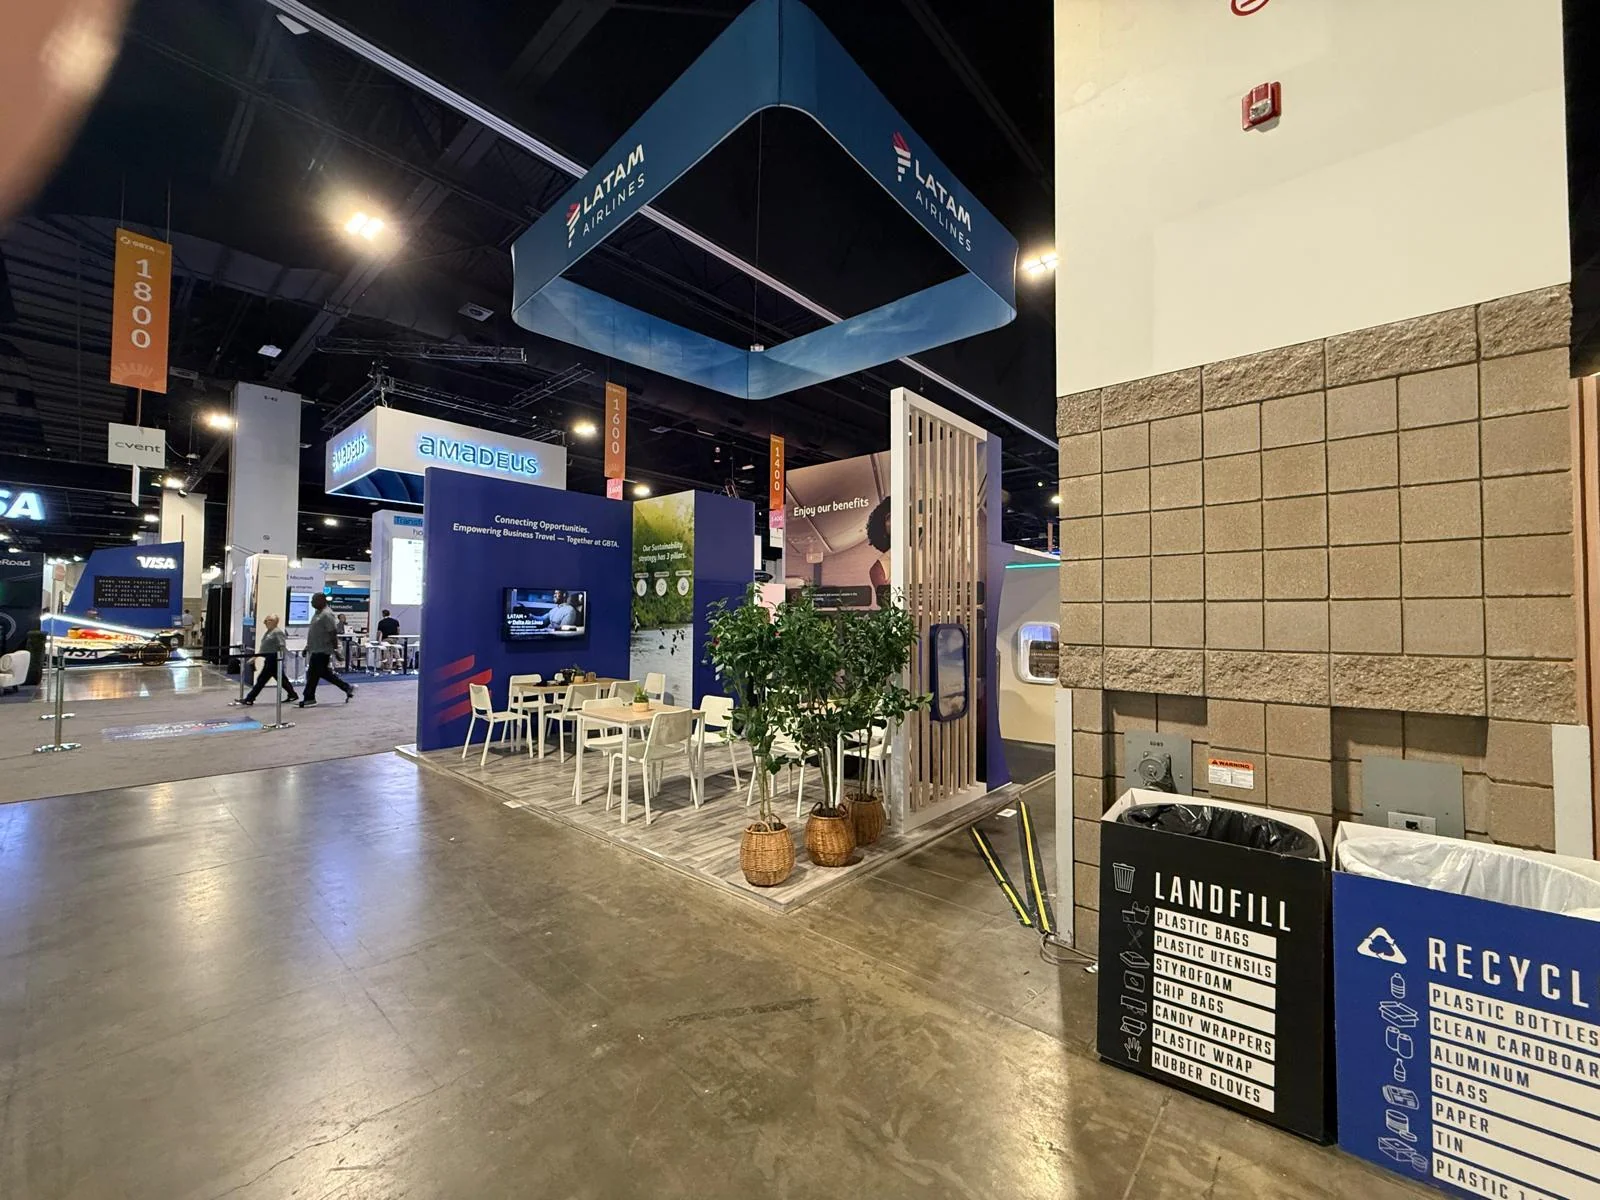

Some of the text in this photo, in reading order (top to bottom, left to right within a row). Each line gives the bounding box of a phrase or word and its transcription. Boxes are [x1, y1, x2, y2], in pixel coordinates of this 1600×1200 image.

[583, 144, 645, 214] LATAM
[915, 159, 972, 231] LATAM
[582, 173, 645, 237] AIRLINES
[916, 190, 972, 252] AIRLINES
[131, 259, 152, 348] 1800
[115, 441, 161, 453] cvent
[612, 398, 620, 455] 1600
[494, 514, 590, 534] Connecting Opportunities.
[793, 497, 869, 518] Enjoy our benefits
[453, 523, 501, 537] Empowering
[503, 528, 533, 539] Business
[535, 532, 556, 541] Travel
[566, 535, 593, 546] Together
[602, 539, 620, 548] GBTA.
[652, 541, 683, 551] Sustainability
[136, 556, 176, 569] VISA
[332, 563, 355, 571] HRS
[638, 555, 656, 563] strategy
[657, 553, 665, 561] has
[1219, 761, 1250, 769] WARNING
[1155, 872, 1291, 932] LANDFILL
[1157, 911, 1250, 947] PLASTIC BAGS
[1156, 935, 1272, 978] PLASTIC UTENSILS
[1156, 958, 1232, 992] STYROFOAM
[1428, 937, 1589, 1008] RECYCL
[1155, 981, 1224, 1014] CHIP BAGS
[1433, 989, 1599, 1046] PLASTIC BOTTLES
[1155, 1006, 1272, 1056] CANDY WRAPPERS
[1155, 1029, 1253, 1074] PLASTIC WRAP
[1433, 1017, 1600, 1079] CLEAN CARDBOAR
[1154, 1052, 1260, 1103] RUBBER GLOVES
[1434, 1045, 1530, 1088] ALUMINUM
[1435, 1074, 1488, 1104] GLASS
[1436, 1102, 1490, 1134] PAPER
[1436, 1130, 1464, 1153] TIN
[1436, 1159, 1508, 1200] PLASTIC
